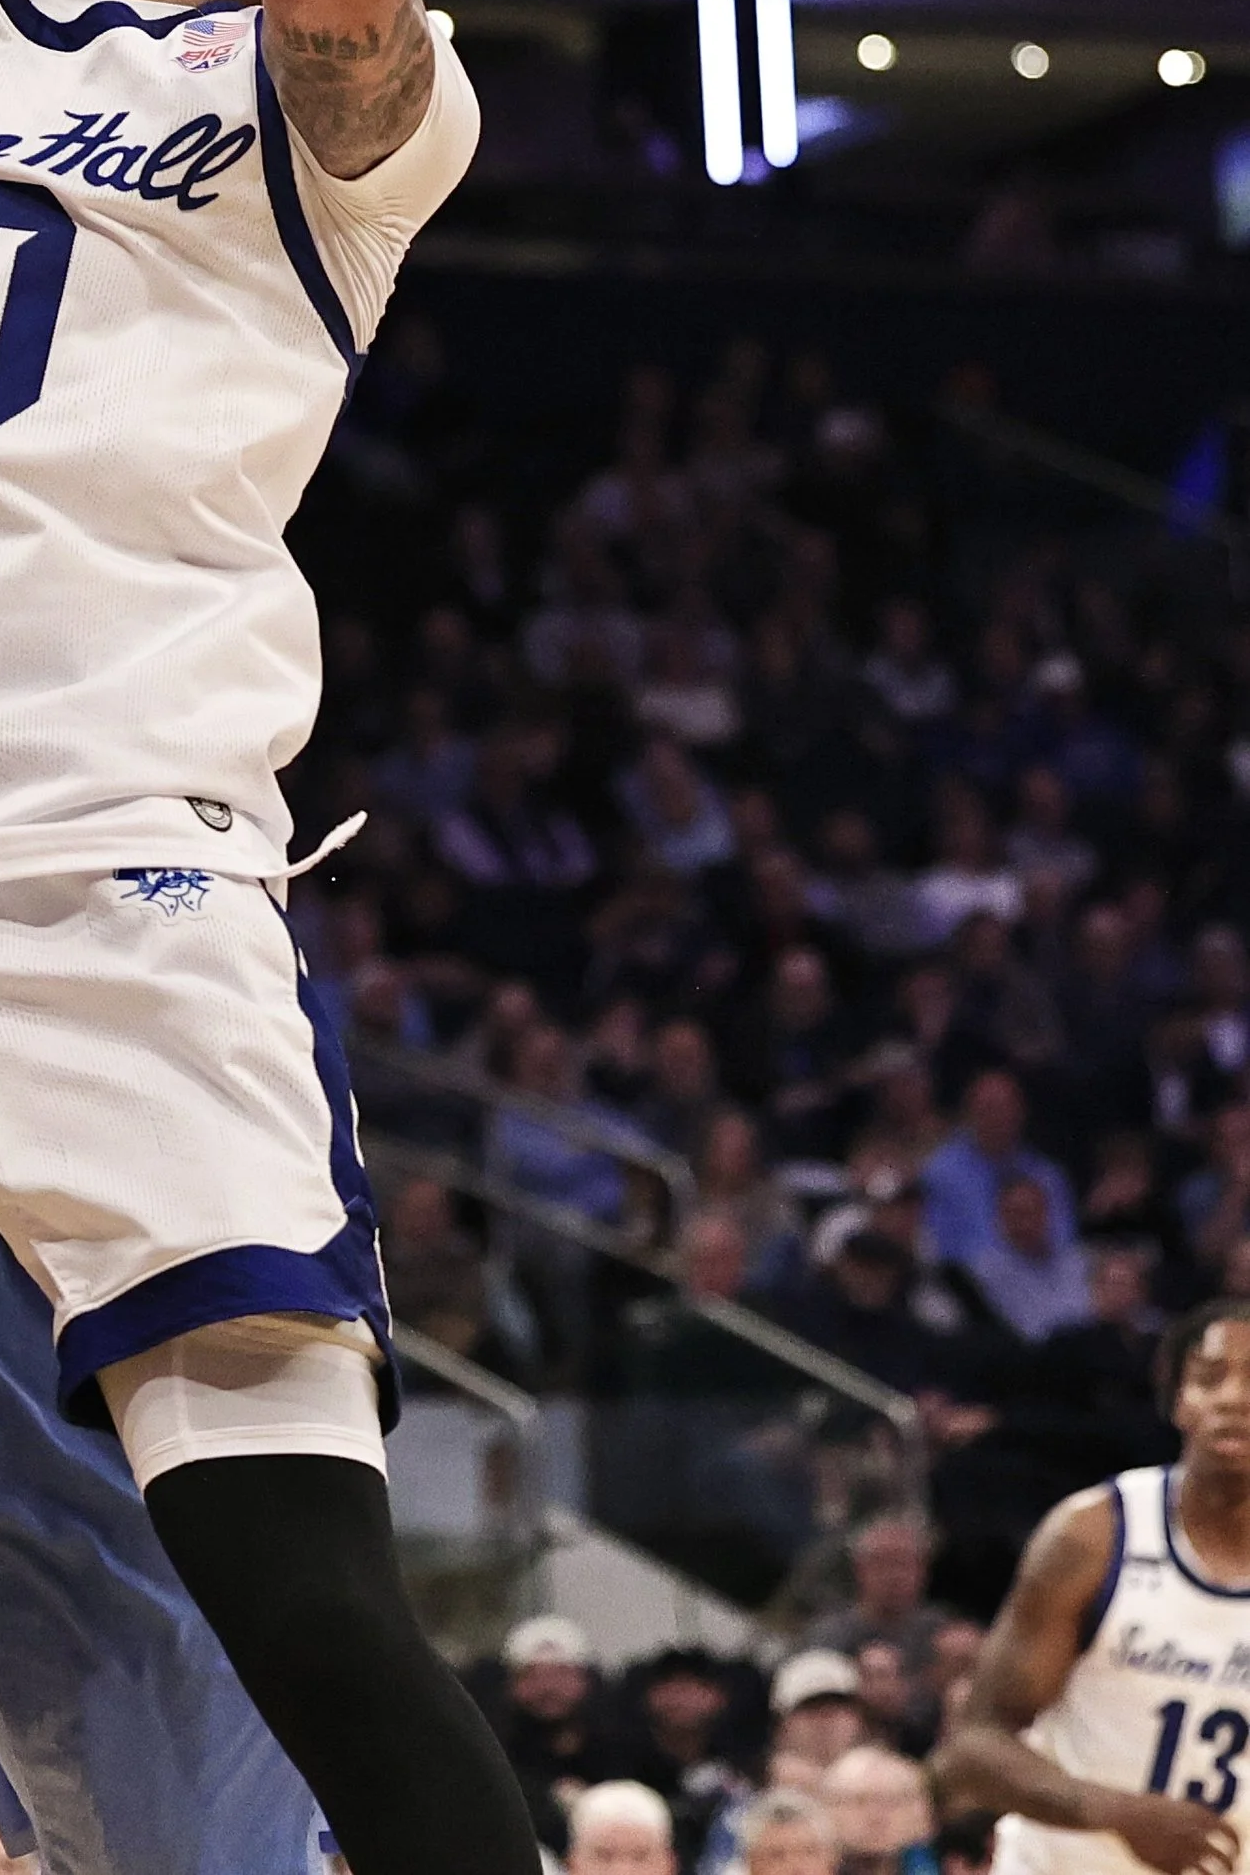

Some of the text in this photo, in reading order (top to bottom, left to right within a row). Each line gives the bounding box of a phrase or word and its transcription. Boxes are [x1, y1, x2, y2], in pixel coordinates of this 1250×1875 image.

[181, 43, 235, 61] BIG
[20, 110, 256, 211] Hall
[1147, 1700, 1250, 1815] 13
